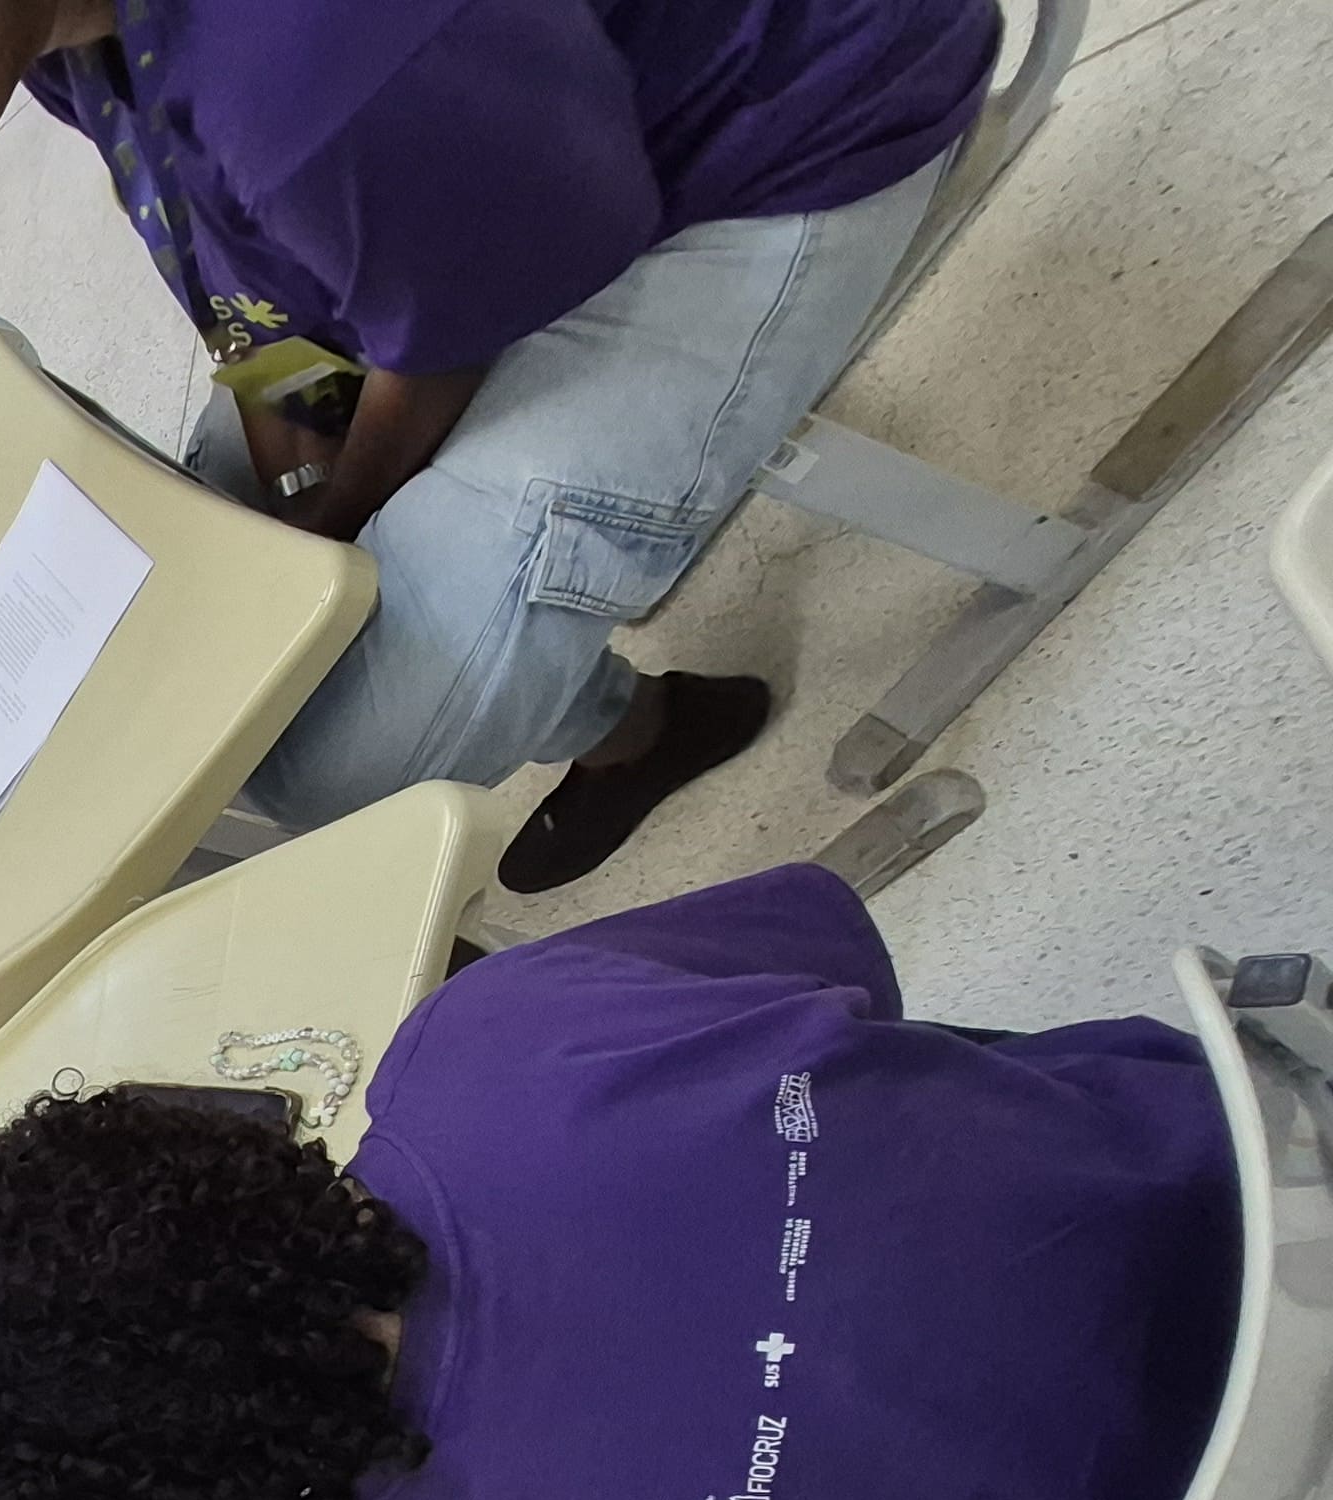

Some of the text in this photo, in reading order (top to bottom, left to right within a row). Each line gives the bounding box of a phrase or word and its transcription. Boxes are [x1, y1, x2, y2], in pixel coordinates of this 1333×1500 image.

[781, 1072, 812, 1142] BRASIL
[763, 1363, 781, 1388] SUS
[746, 1414, 788, 1494] FIOCRUZ
